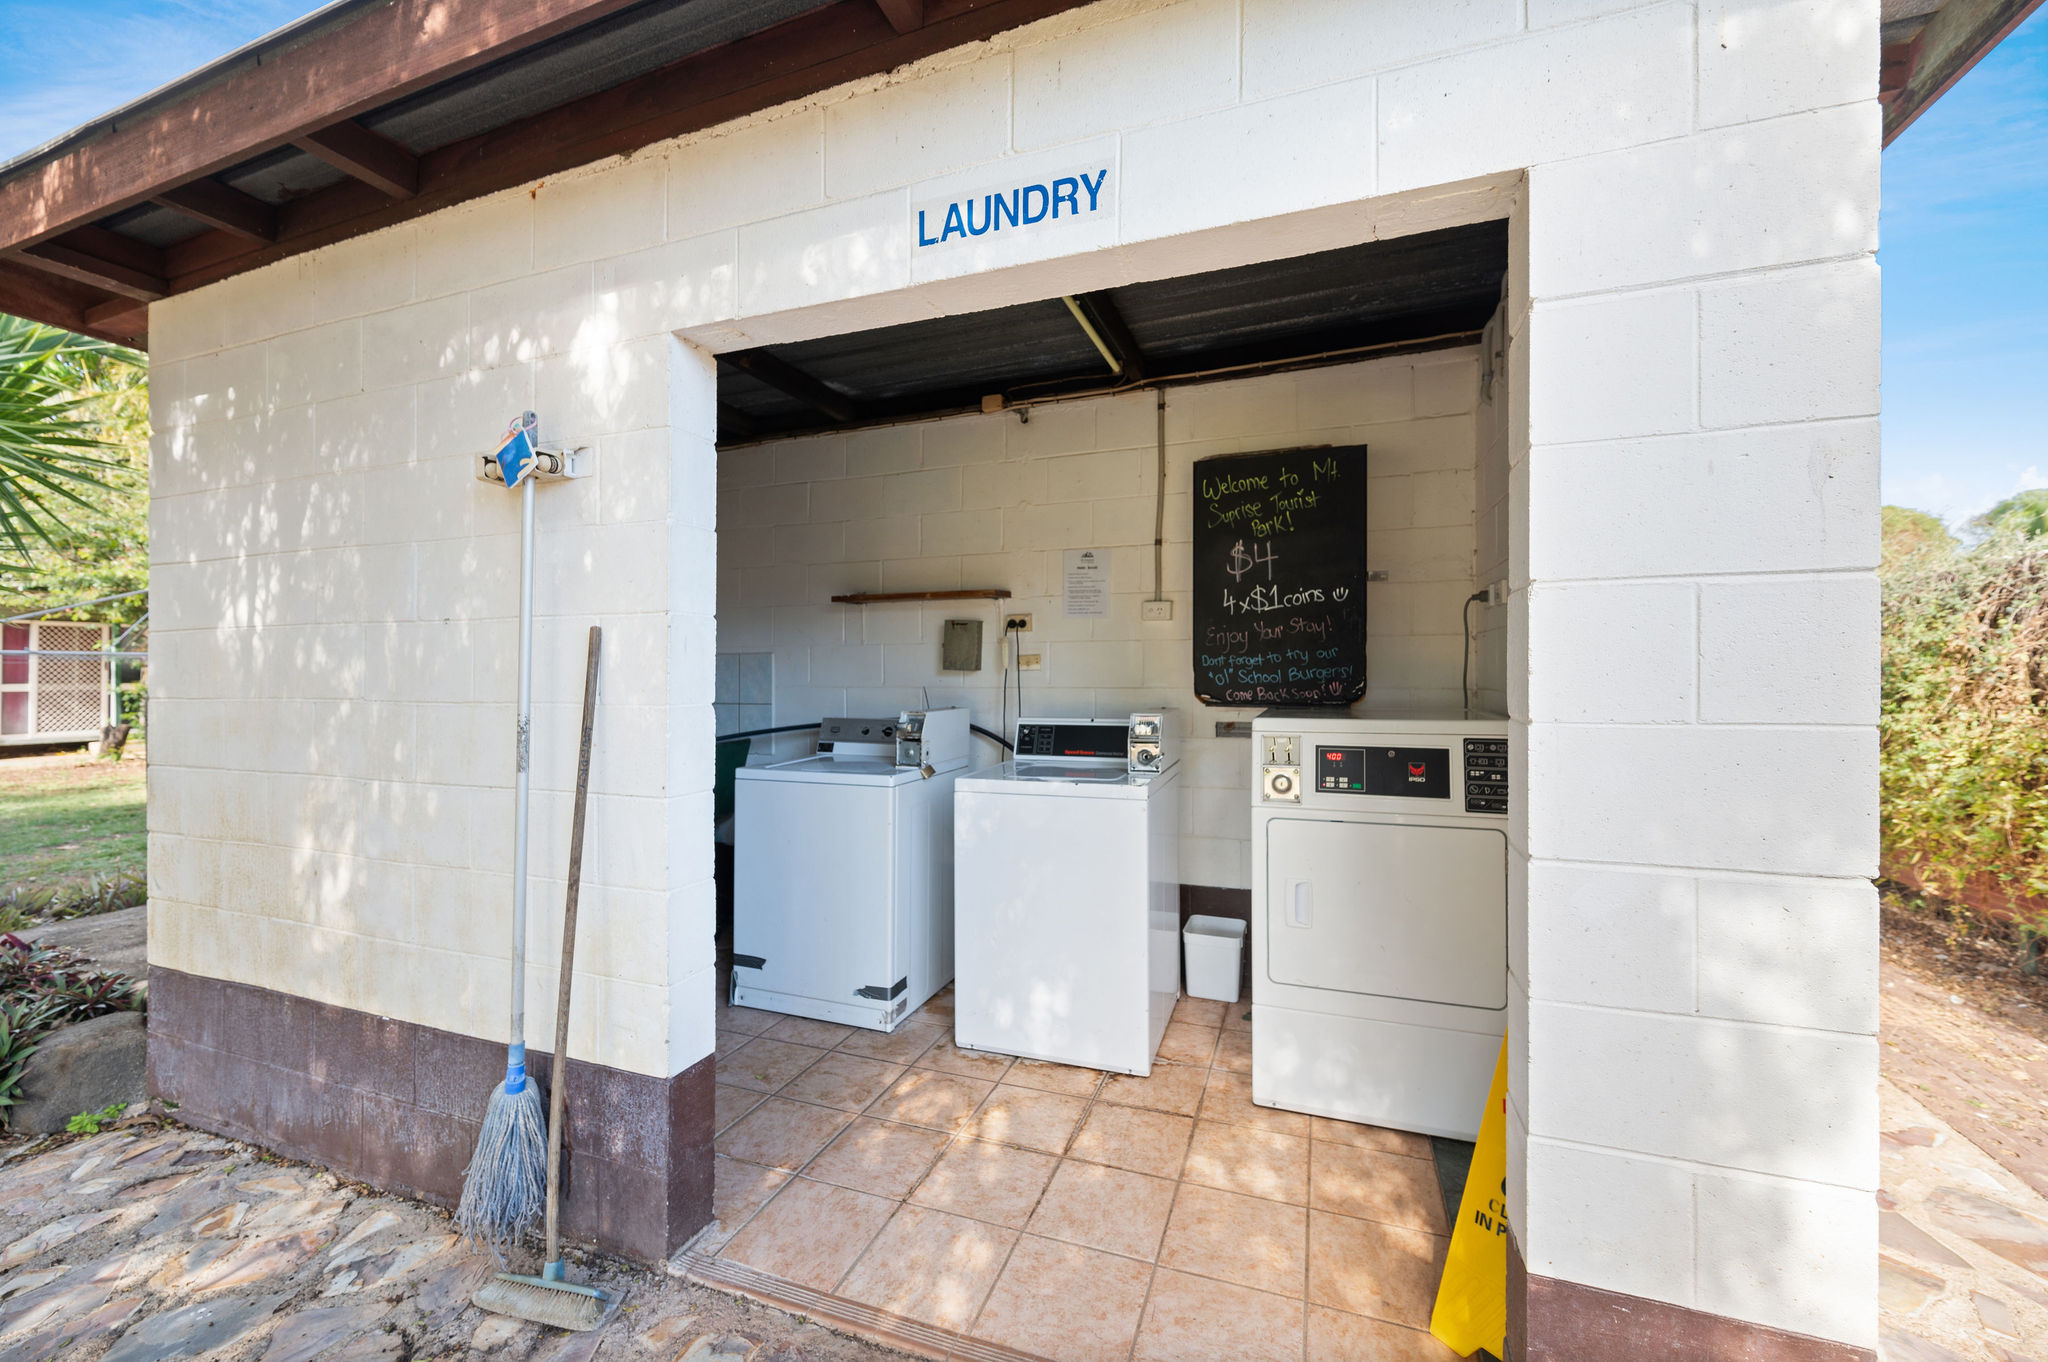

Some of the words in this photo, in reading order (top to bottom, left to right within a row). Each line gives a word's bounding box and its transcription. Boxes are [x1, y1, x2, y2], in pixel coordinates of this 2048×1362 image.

[918, 168, 1108, 247] LAUNDRY
[1202, 474, 1269, 500] Welcome
[1279, 466, 1299, 487] to
[1208, 500, 1263, 528] Suprise
[1270, 488, 1322, 513] Tourist
[1251, 510, 1295, 538] Park!
[1226, 539, 1279, 583] $4
[1205, 624, 1249, 653] Enjoy
[1253, 620, 1284, 641] Your
[1285, 615, 1333, 641] Stay!
[1228, 653, 1264, 670] forget
[1266, 651, 1282, 664] to
[1286, 648, 1309, 665] try
[1316, 647, 1339, 658] our
[1238, 669, 1282, 684] School
[1225, 689, 1253, 701] Come
[1256, 686, 1290, 701] Back
[1474, 1209, 1493, 1232] IN
